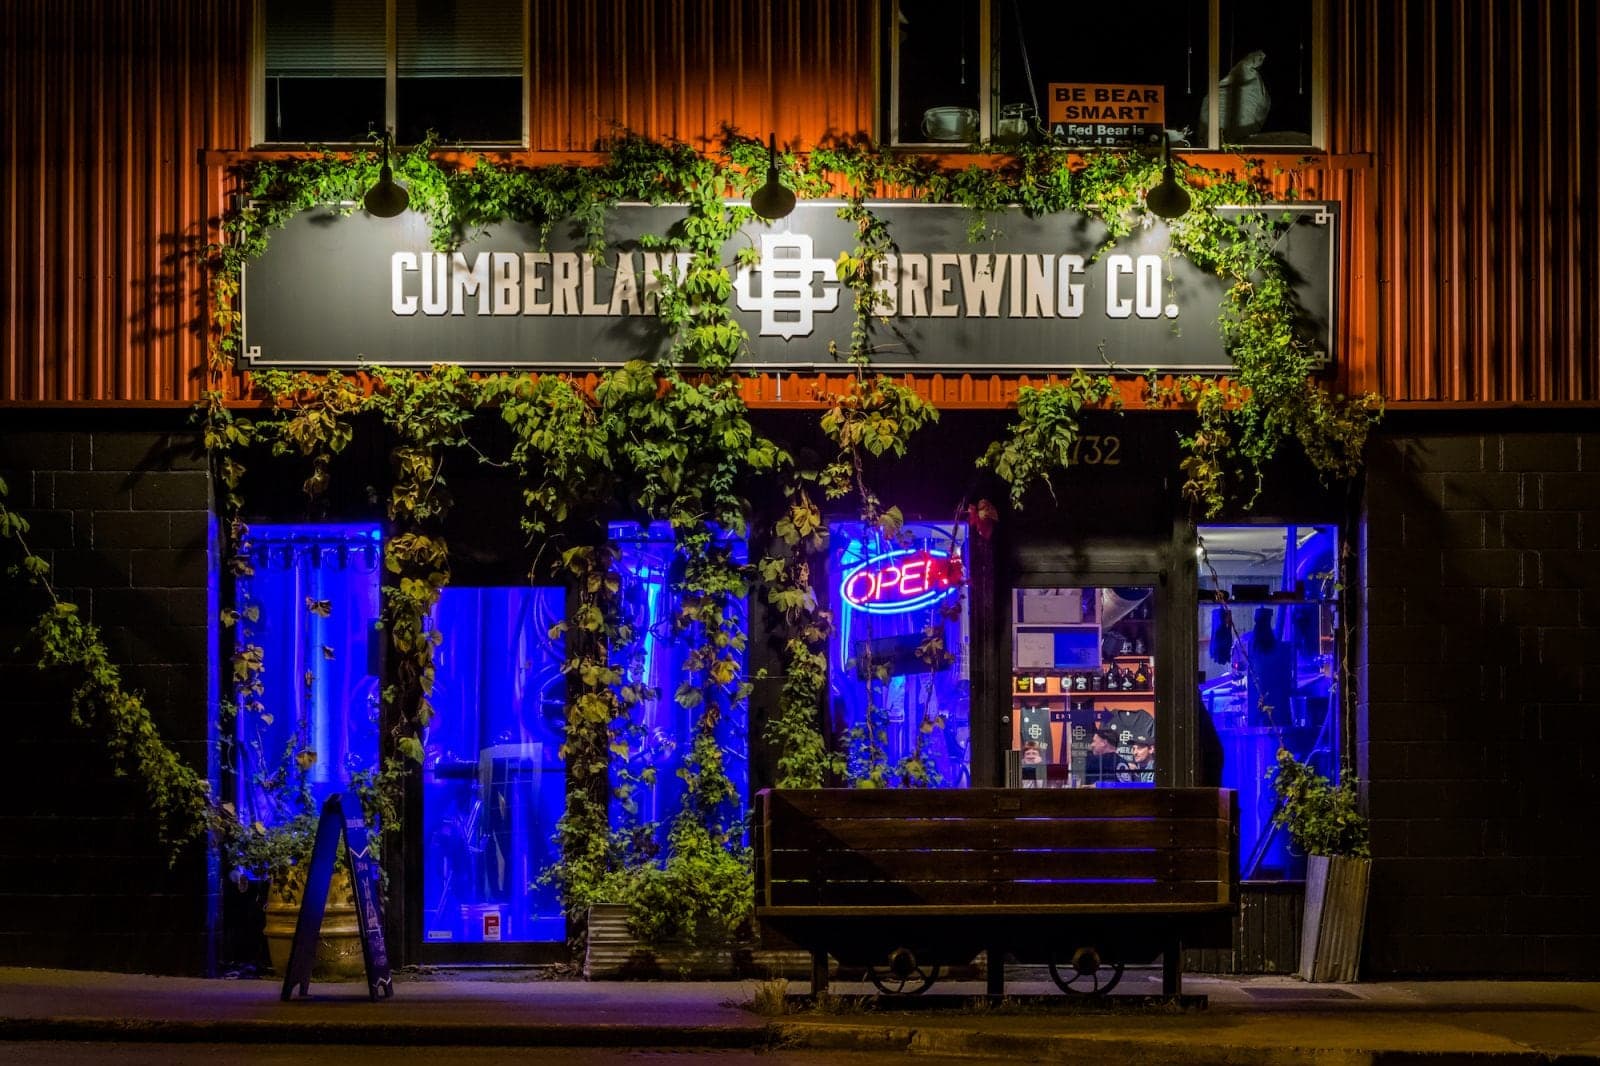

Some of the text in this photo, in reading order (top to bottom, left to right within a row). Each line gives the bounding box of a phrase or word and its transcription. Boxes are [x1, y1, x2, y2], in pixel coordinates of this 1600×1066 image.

[1055, 88, 1159, 103] BE BEAR
[1066, 106, 1149, 120] SMART
[1054, 124, 1145, 135] A Fed Bear is
[871, 253, 1085, 318] BREWING
[1106, 254, 1179, 318] CO.
